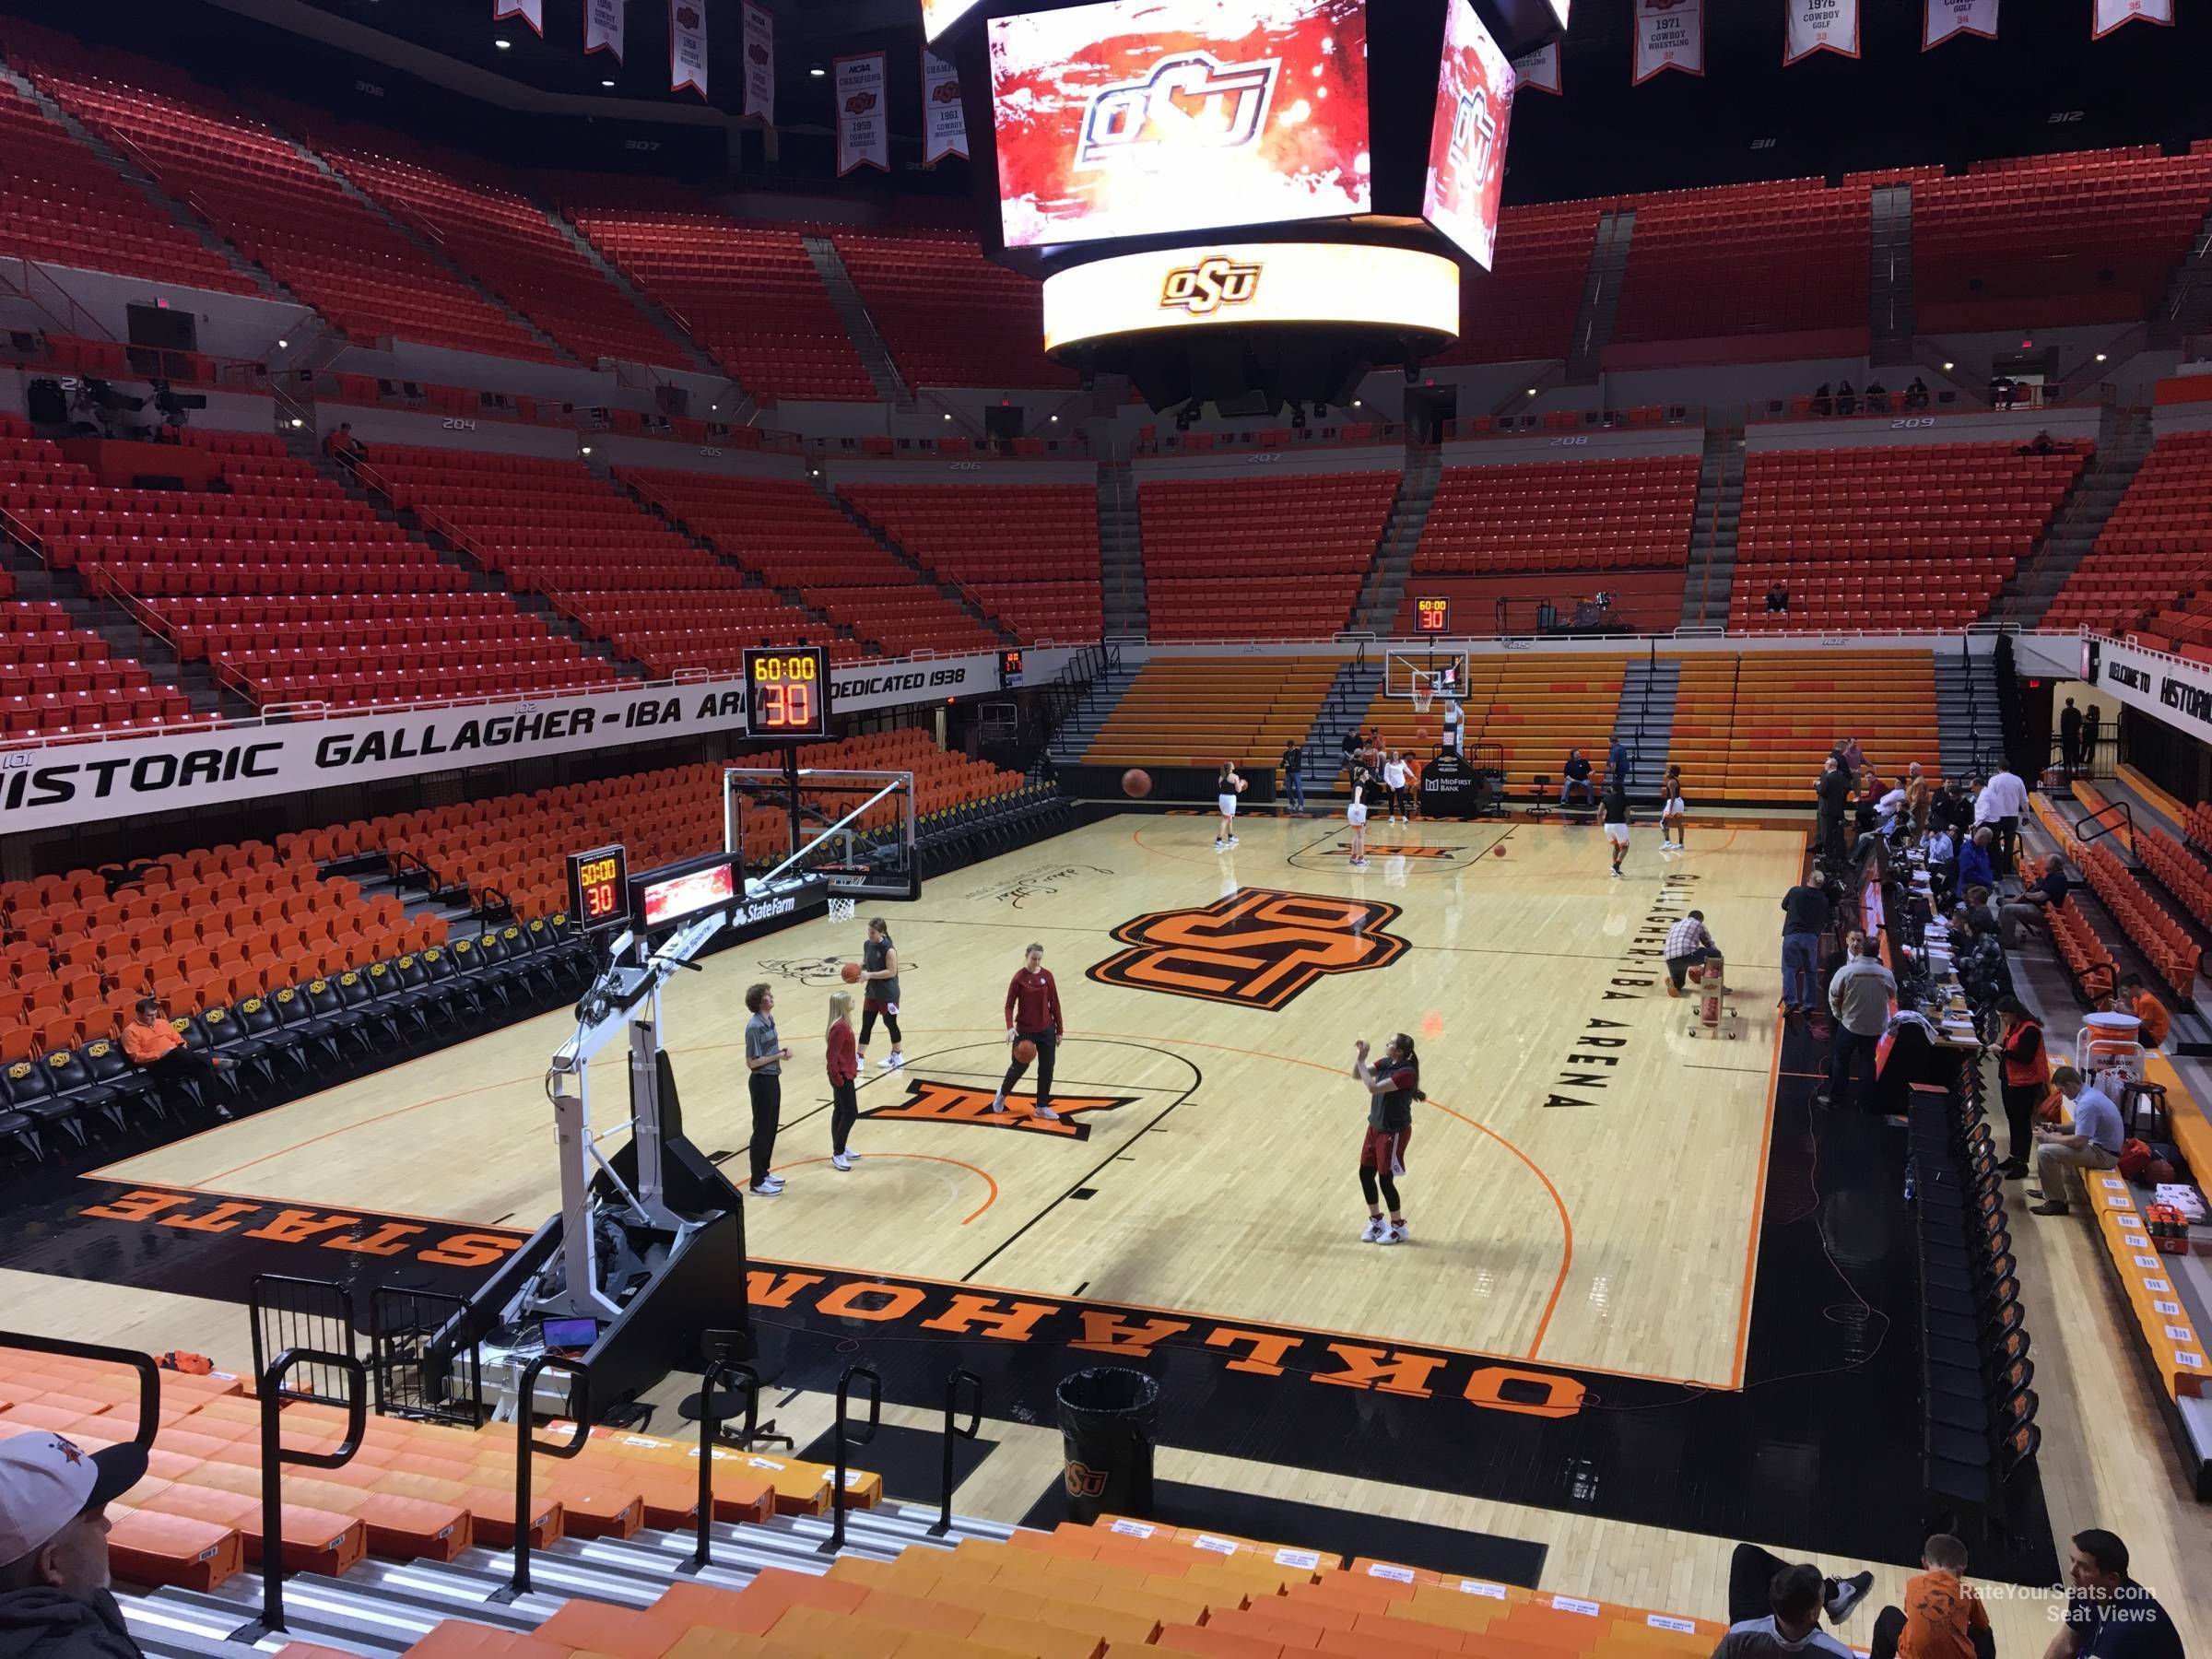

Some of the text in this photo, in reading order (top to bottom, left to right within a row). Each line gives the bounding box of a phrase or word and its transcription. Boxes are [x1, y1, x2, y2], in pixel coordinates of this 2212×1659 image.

[1953, 4, 1973, 13] GOLF
[1803, 10, 1840, 22] COWBOY
[1656, 18, 1681, 30] 1971
[1812, 20, 1831, 29] GOLF
[1651, 30, 1686, 41] COWBOY
[1648, 39, 1689, 50] WRESTLING
[849, 64, 870, 74] NCAA
[839, 74, 881, 86] CHAMPIONS
[1074, 51, 1281, 172] OSU
[2048, 111, 2084, 123] 312
[936, 122, 962, 131] COWBOY
[624, 140, 661, 151] 307
[1750, 139, 1776, 149] 311
[1159, 255, 1263, 316] OSU
[442, 418, 476, 431] 204
[1891, 418, 1935, 429] 209
[1550, 435, 1587, 446] 208
[1419, 601, 1446, 610] 60:00
[1423, 611, 1443, 628] 30
[755, 657, 815, 680] 60:00
[2109, 661, 2139, 689] WELCOME
[2139, 672, 2150, 693] TO
[766, 684, 809, 725] 30
[0, 742, 283, 809] ISTORIC
[830, 673, 924, 700] DEDICATED
[930, 668, 966, 687] 1938
[582, 859, 616, 886] 60:00
[588, 885, 613, 914] 30
[1543, 1018, 1635, 1108] ARENA
[78, 1191, 524, 1267] STATE
